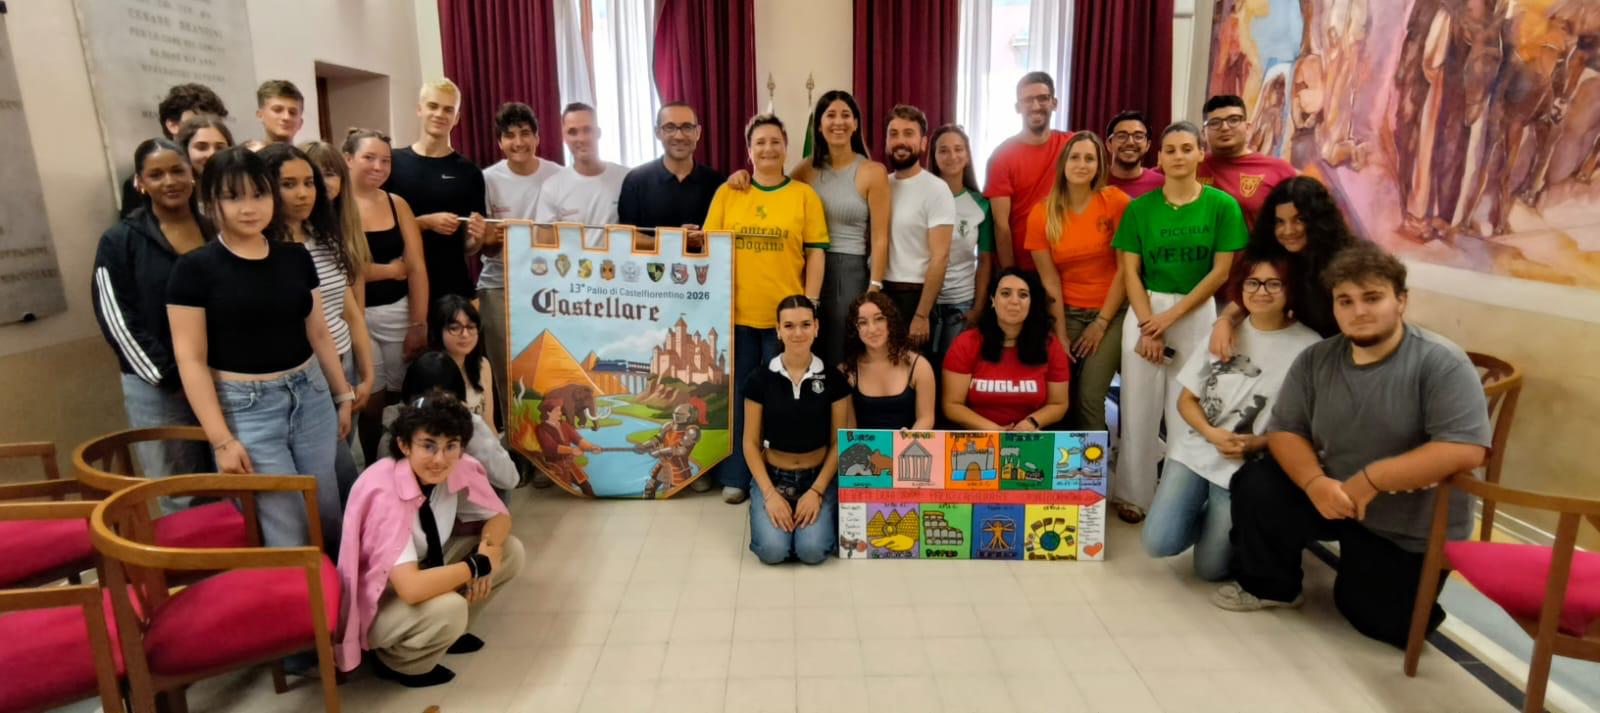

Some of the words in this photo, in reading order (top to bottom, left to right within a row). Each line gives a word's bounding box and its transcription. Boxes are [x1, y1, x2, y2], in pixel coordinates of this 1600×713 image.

[531, 287, 660, 322] Castellare
[587, 286, 608, 296] Palio
[610, 287, 618, 295] di
[619, 288, 685, 300] Castelfiorentino
[686, 291, 710, 300] 2026
